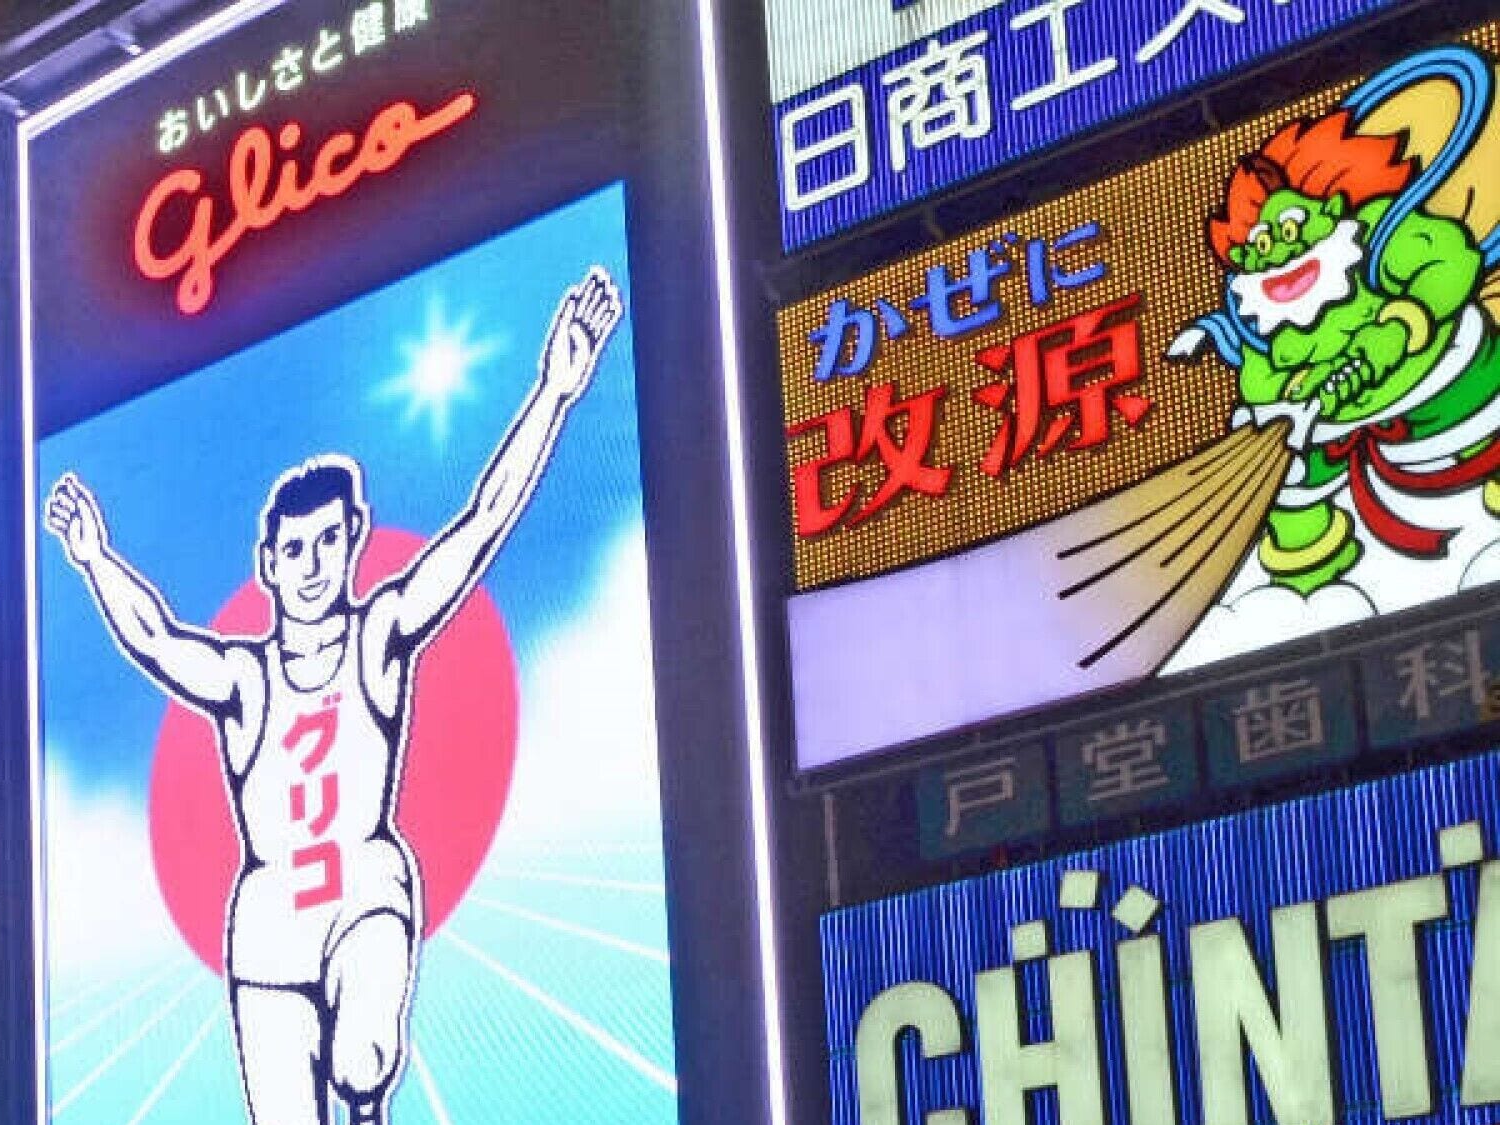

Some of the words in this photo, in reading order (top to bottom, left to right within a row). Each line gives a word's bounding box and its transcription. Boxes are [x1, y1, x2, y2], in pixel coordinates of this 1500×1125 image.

[134, 88, 479, 315] Glico
[781, 0, 1295, 210] 日商エス
[809, 222, 1106, 381] かぜに
[783, 294, 1153, 539] 改源
[281, 692, 343, 910] グリコ
